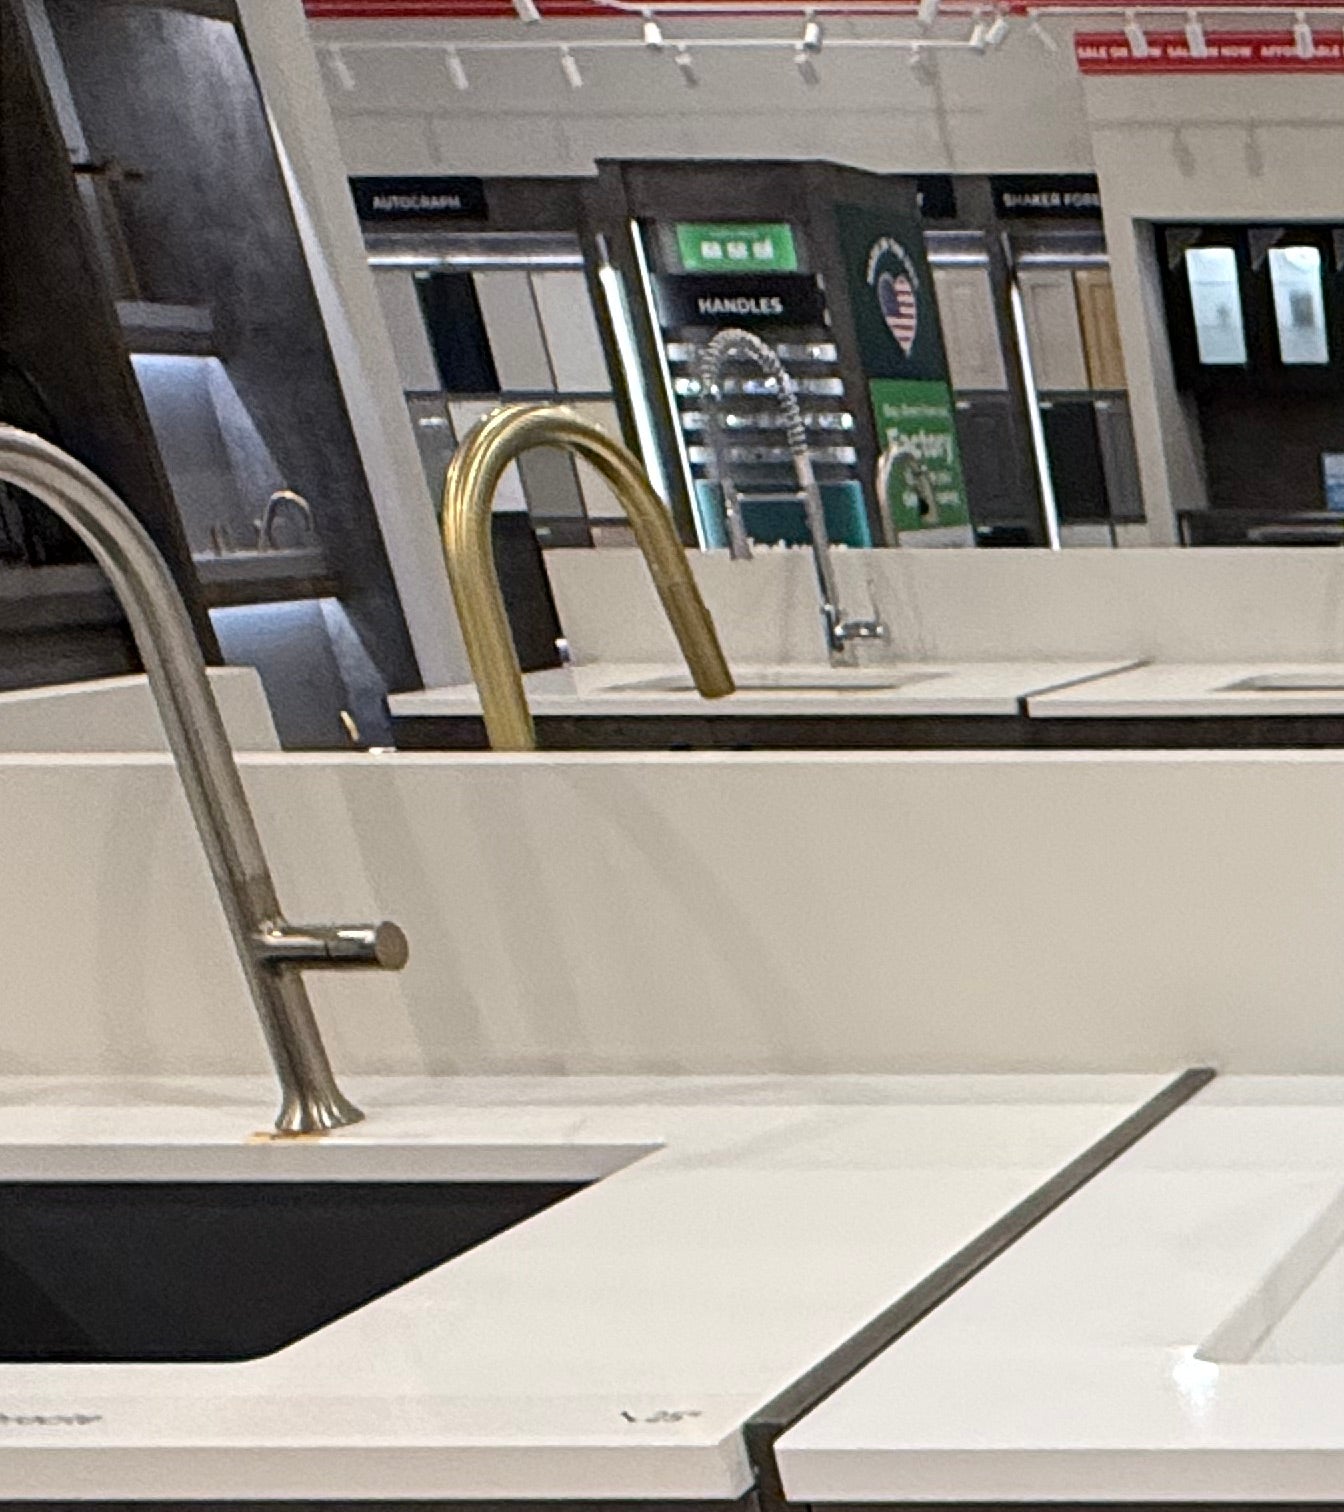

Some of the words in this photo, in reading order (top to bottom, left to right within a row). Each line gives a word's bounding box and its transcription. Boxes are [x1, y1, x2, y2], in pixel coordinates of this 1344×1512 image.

[372, 194, 461, 211] AUTOGRAPH
[1003, 192, 1061, 207] SHAKER
[697, 297, 784, 315] HANDLES
